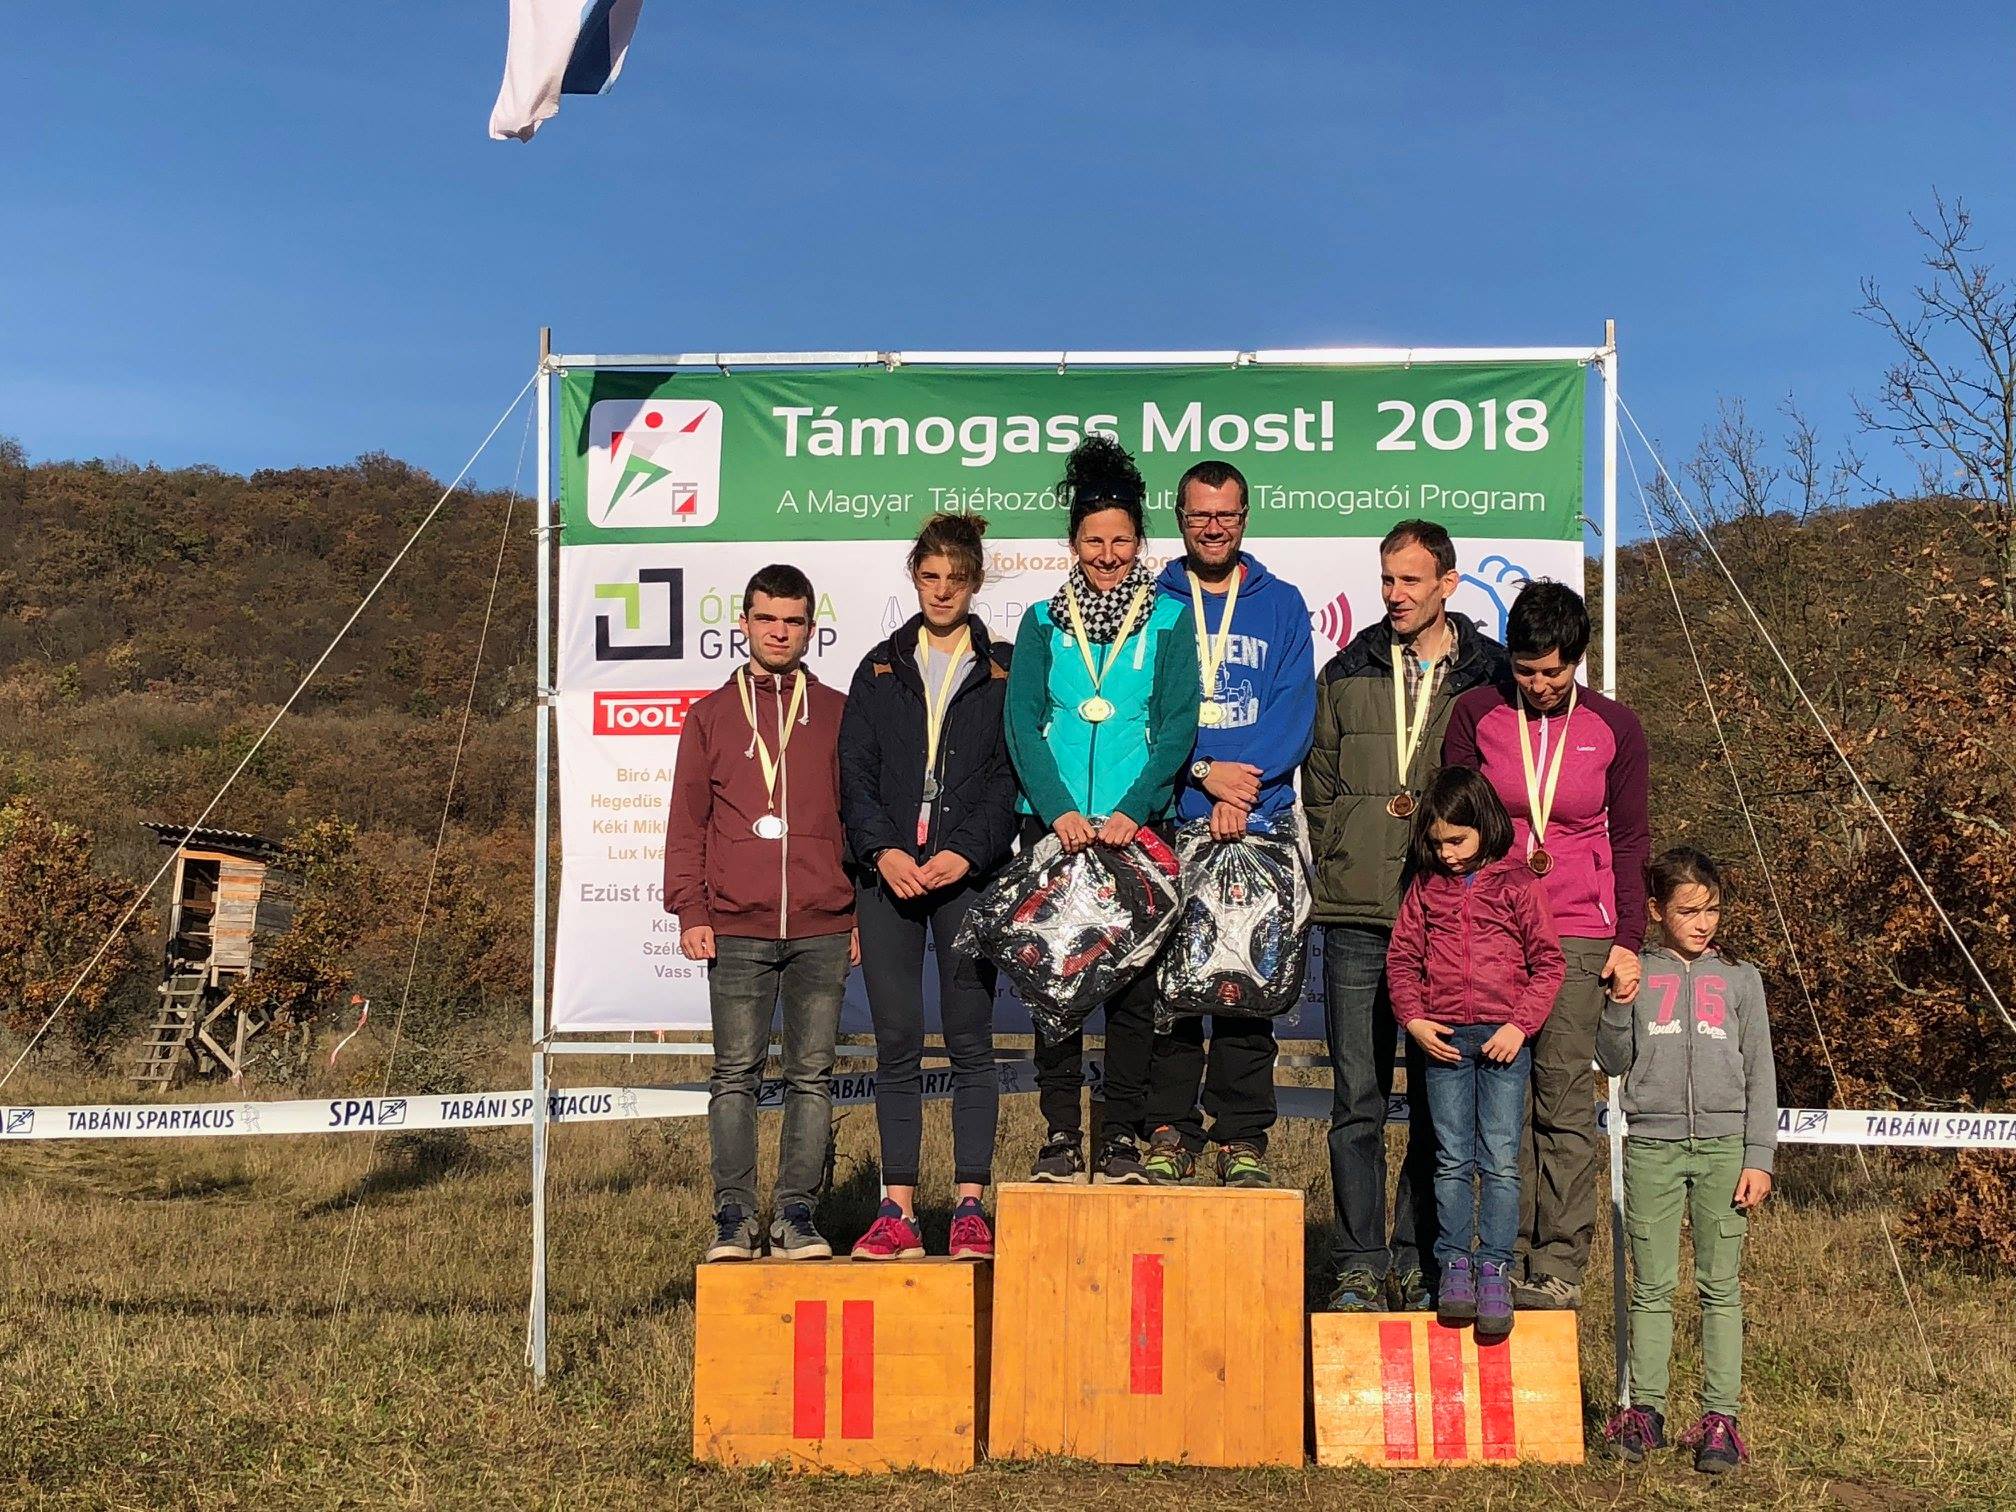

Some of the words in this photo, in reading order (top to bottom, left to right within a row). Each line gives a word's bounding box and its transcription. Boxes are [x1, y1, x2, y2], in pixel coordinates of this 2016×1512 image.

[1142, 400, 1335, 453] Most!
[1376, 398, 1550, 452] 2018
[776, 490, 800, 514] A
[807, 488, 914, 519] Magyar
[1253, 483, 1411, 515] Támogatói
[1420, 483, 1546, 515] Program
[592, 818, 629, 834] Kéki
[607, 845, 639, 860] Lux
[580, 883, 641, 902] Ezüst
[654, 964, 693, 979] Vass
[328, 1100, 375, 1127] SPA
[440, 1095, 508, 1120] TABÁNI
[510, 1093, 613, 1118] SPRTACUS
[67, 1108, 132, 1131] TABÁNI
[136, 1109, 235, 1129] SPARTACUS
[1865, 1113, 1941, 1138] TABÁNI
